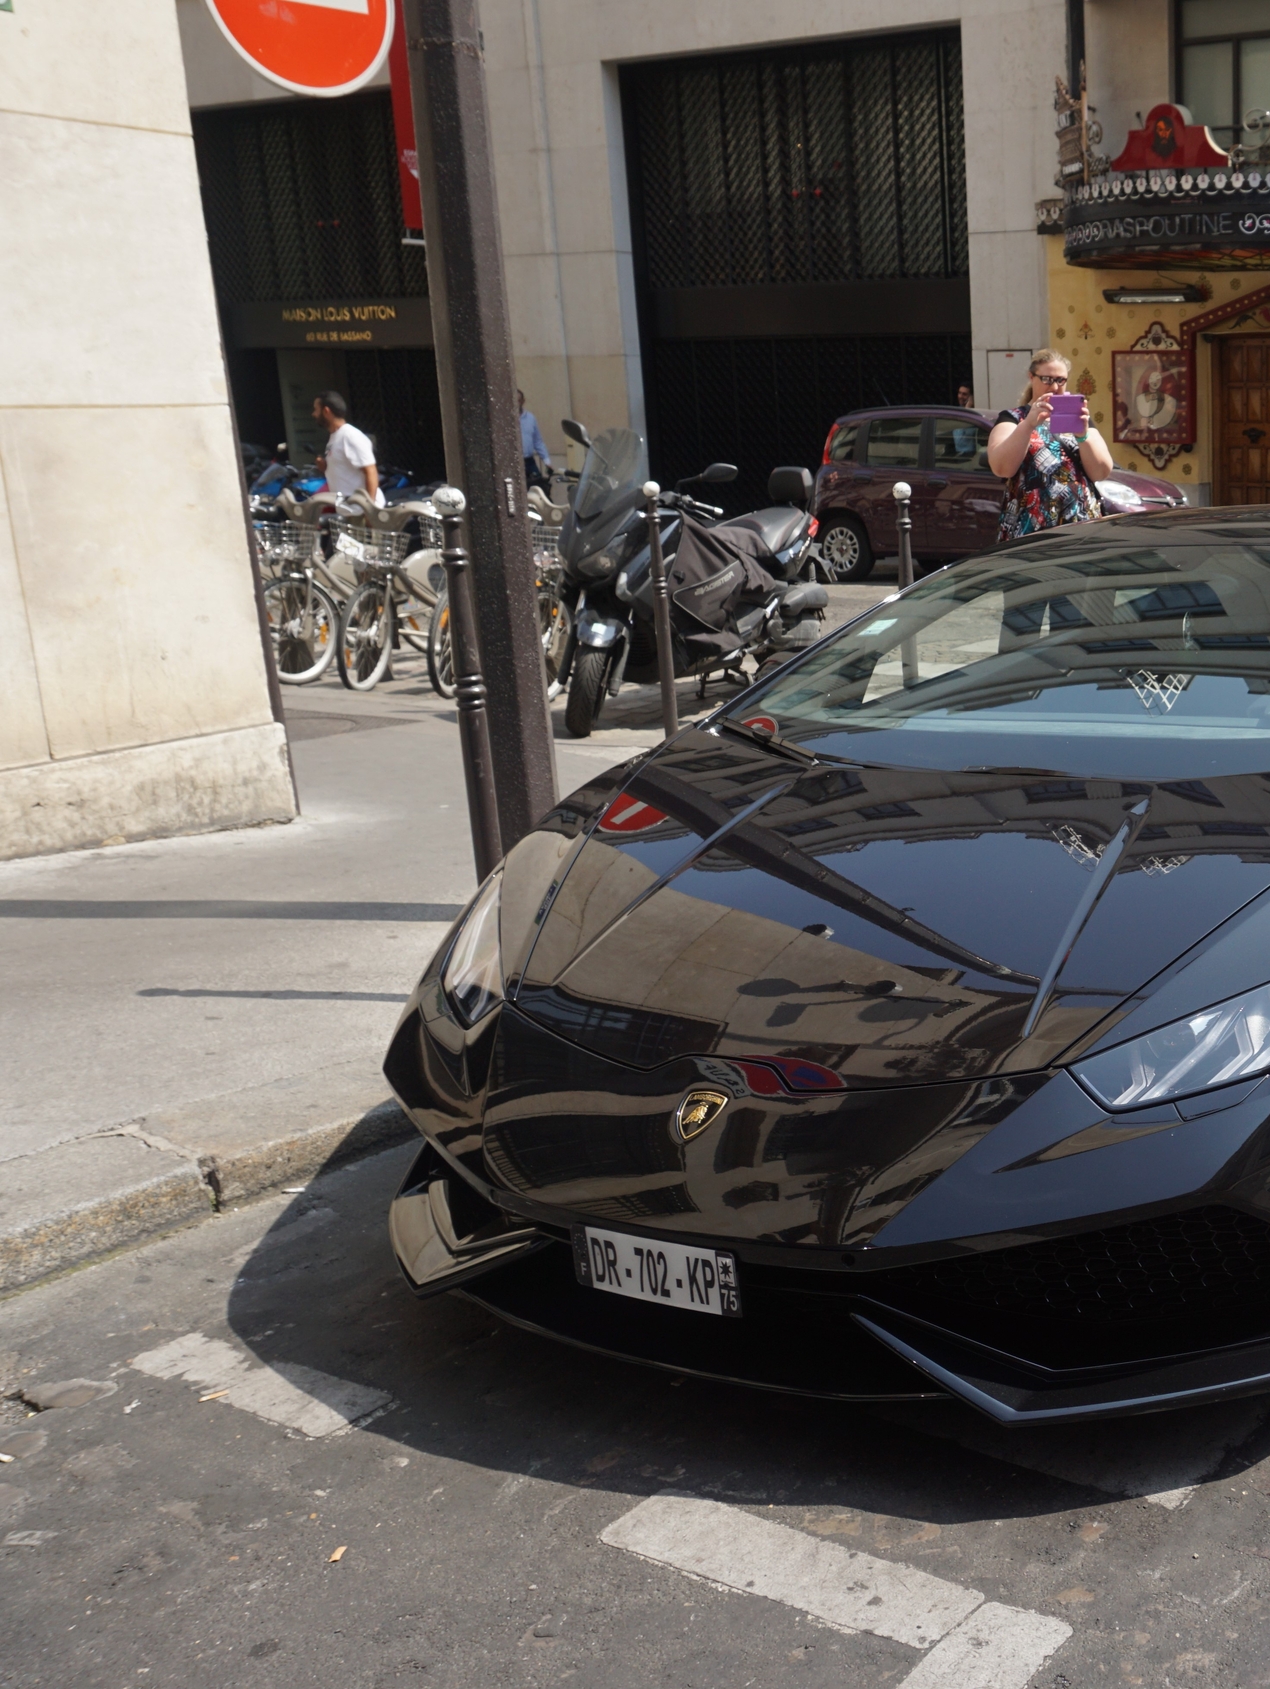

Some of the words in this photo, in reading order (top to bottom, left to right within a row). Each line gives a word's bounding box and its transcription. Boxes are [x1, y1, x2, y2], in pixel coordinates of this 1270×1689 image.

[1100, 213, 1233, 238] RASPOUTINE
[282, 307, 321, 320] MAISON
[323, 307, 350, 320] LOUIS
[352, 306, 396, 320] VUITTON
[581, 1262, 588, 1276] F
[589, 1237, 715, 1306] DR-702-KP
[721, 1289, 738, 1312] 75
